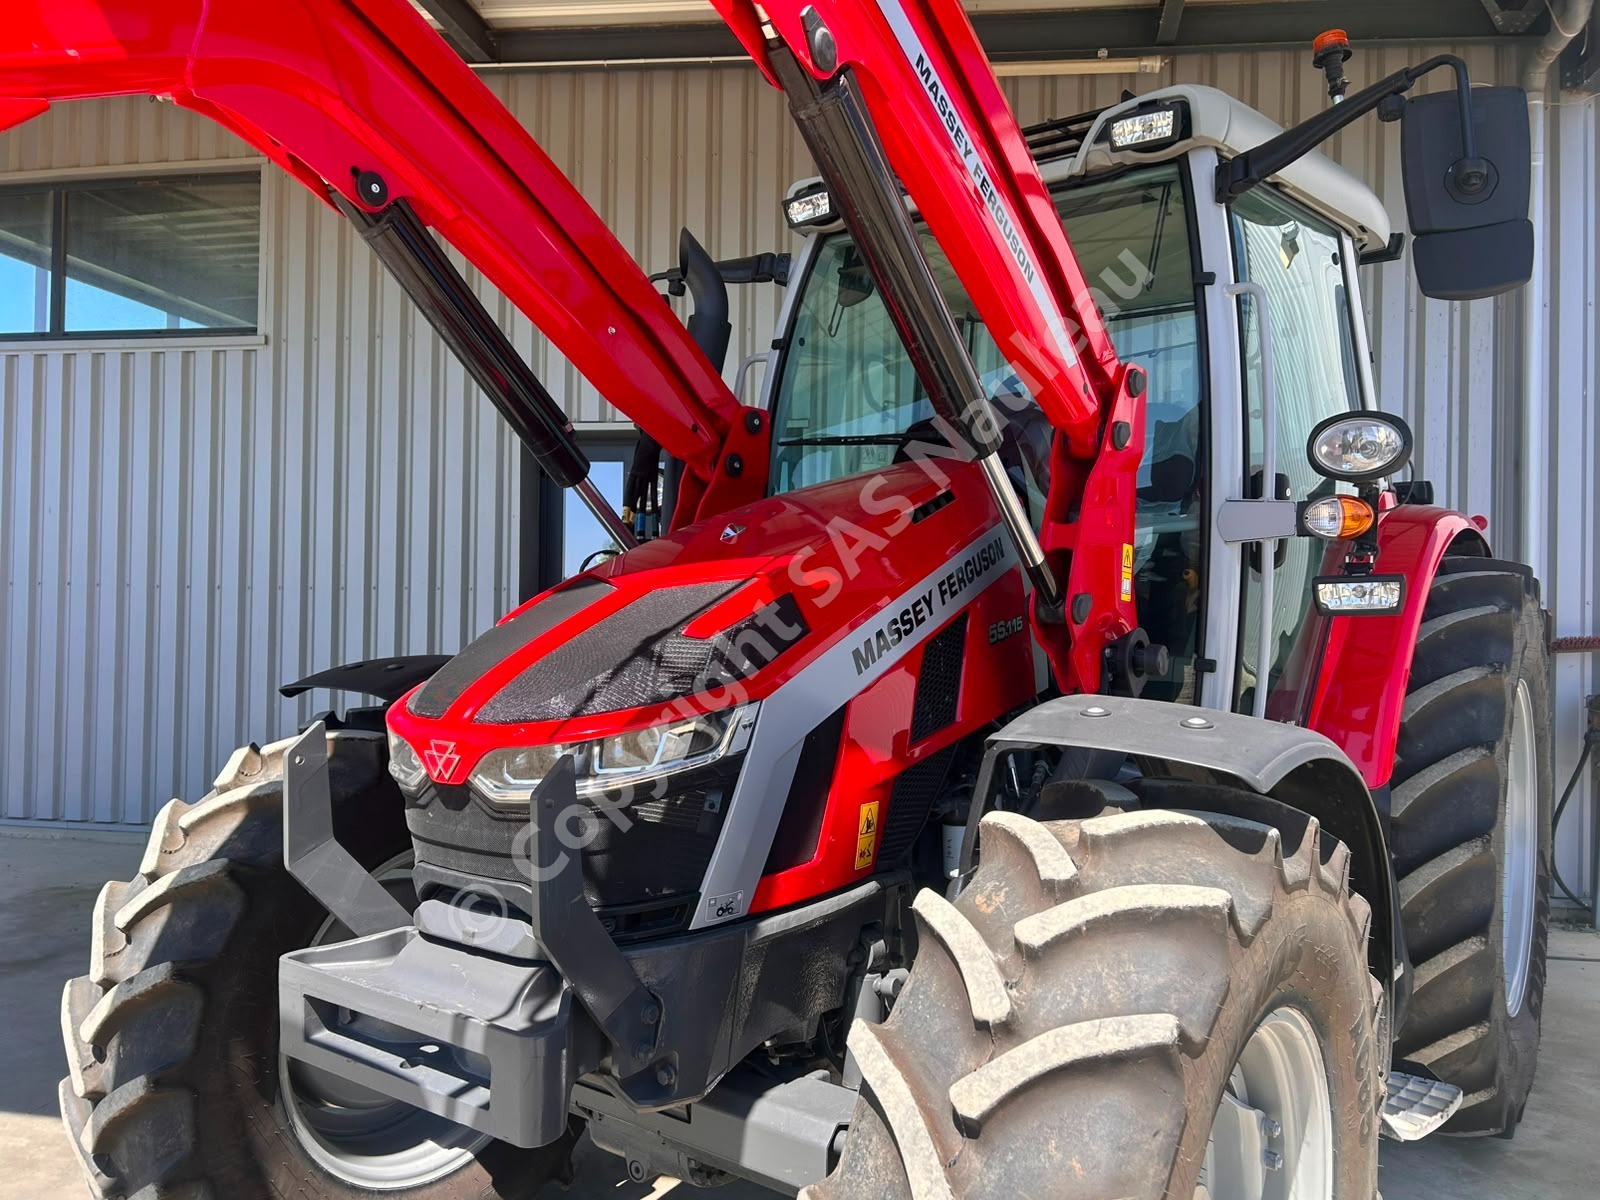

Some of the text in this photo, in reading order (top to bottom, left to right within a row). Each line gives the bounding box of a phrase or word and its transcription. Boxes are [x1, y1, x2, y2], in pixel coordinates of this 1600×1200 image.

[916, 53, 1034, 284] MASSEY FERGUSON
[852, 537, 1005, 676] MASSEY FERGUSON
[989, 615, 1023, 643] 5S.115
